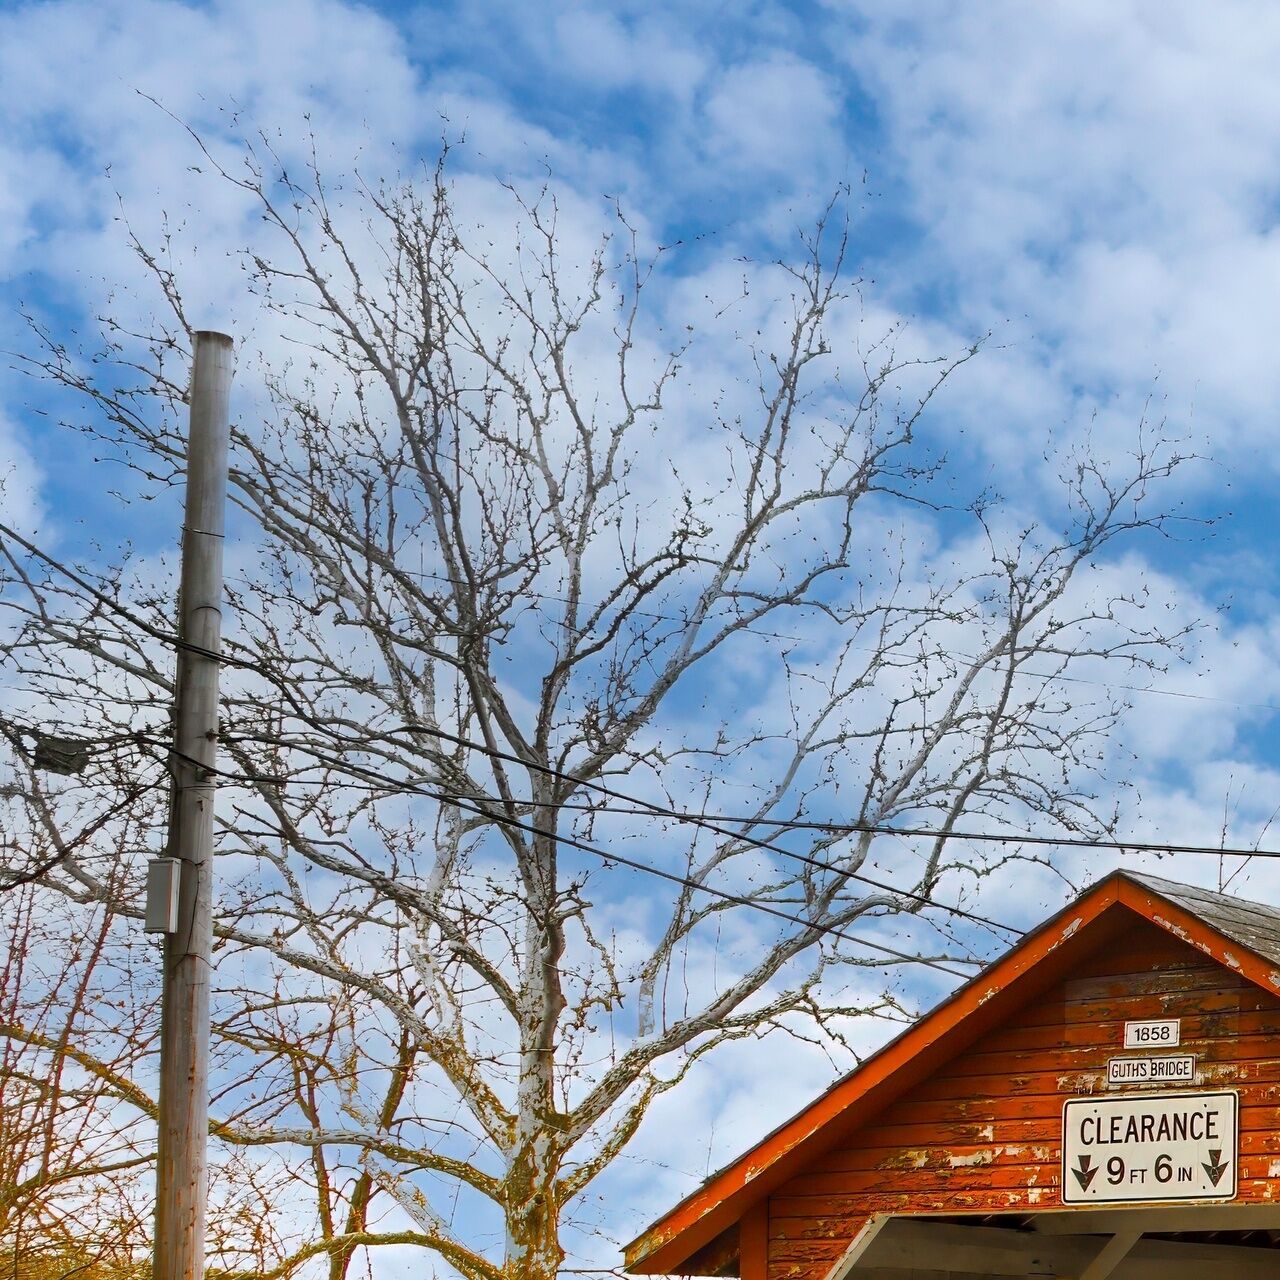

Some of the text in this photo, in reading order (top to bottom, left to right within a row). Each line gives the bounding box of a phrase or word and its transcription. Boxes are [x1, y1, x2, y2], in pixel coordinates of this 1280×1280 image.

[1134, 1026, 1170, 1042] 1858
[1150, 1060, 1190, 1077] BRIDGE
[1080, 1110, 1219, 1146] CLEARANCE
[1106, 1153, 1192, 1185] 9 FT 6 IN
